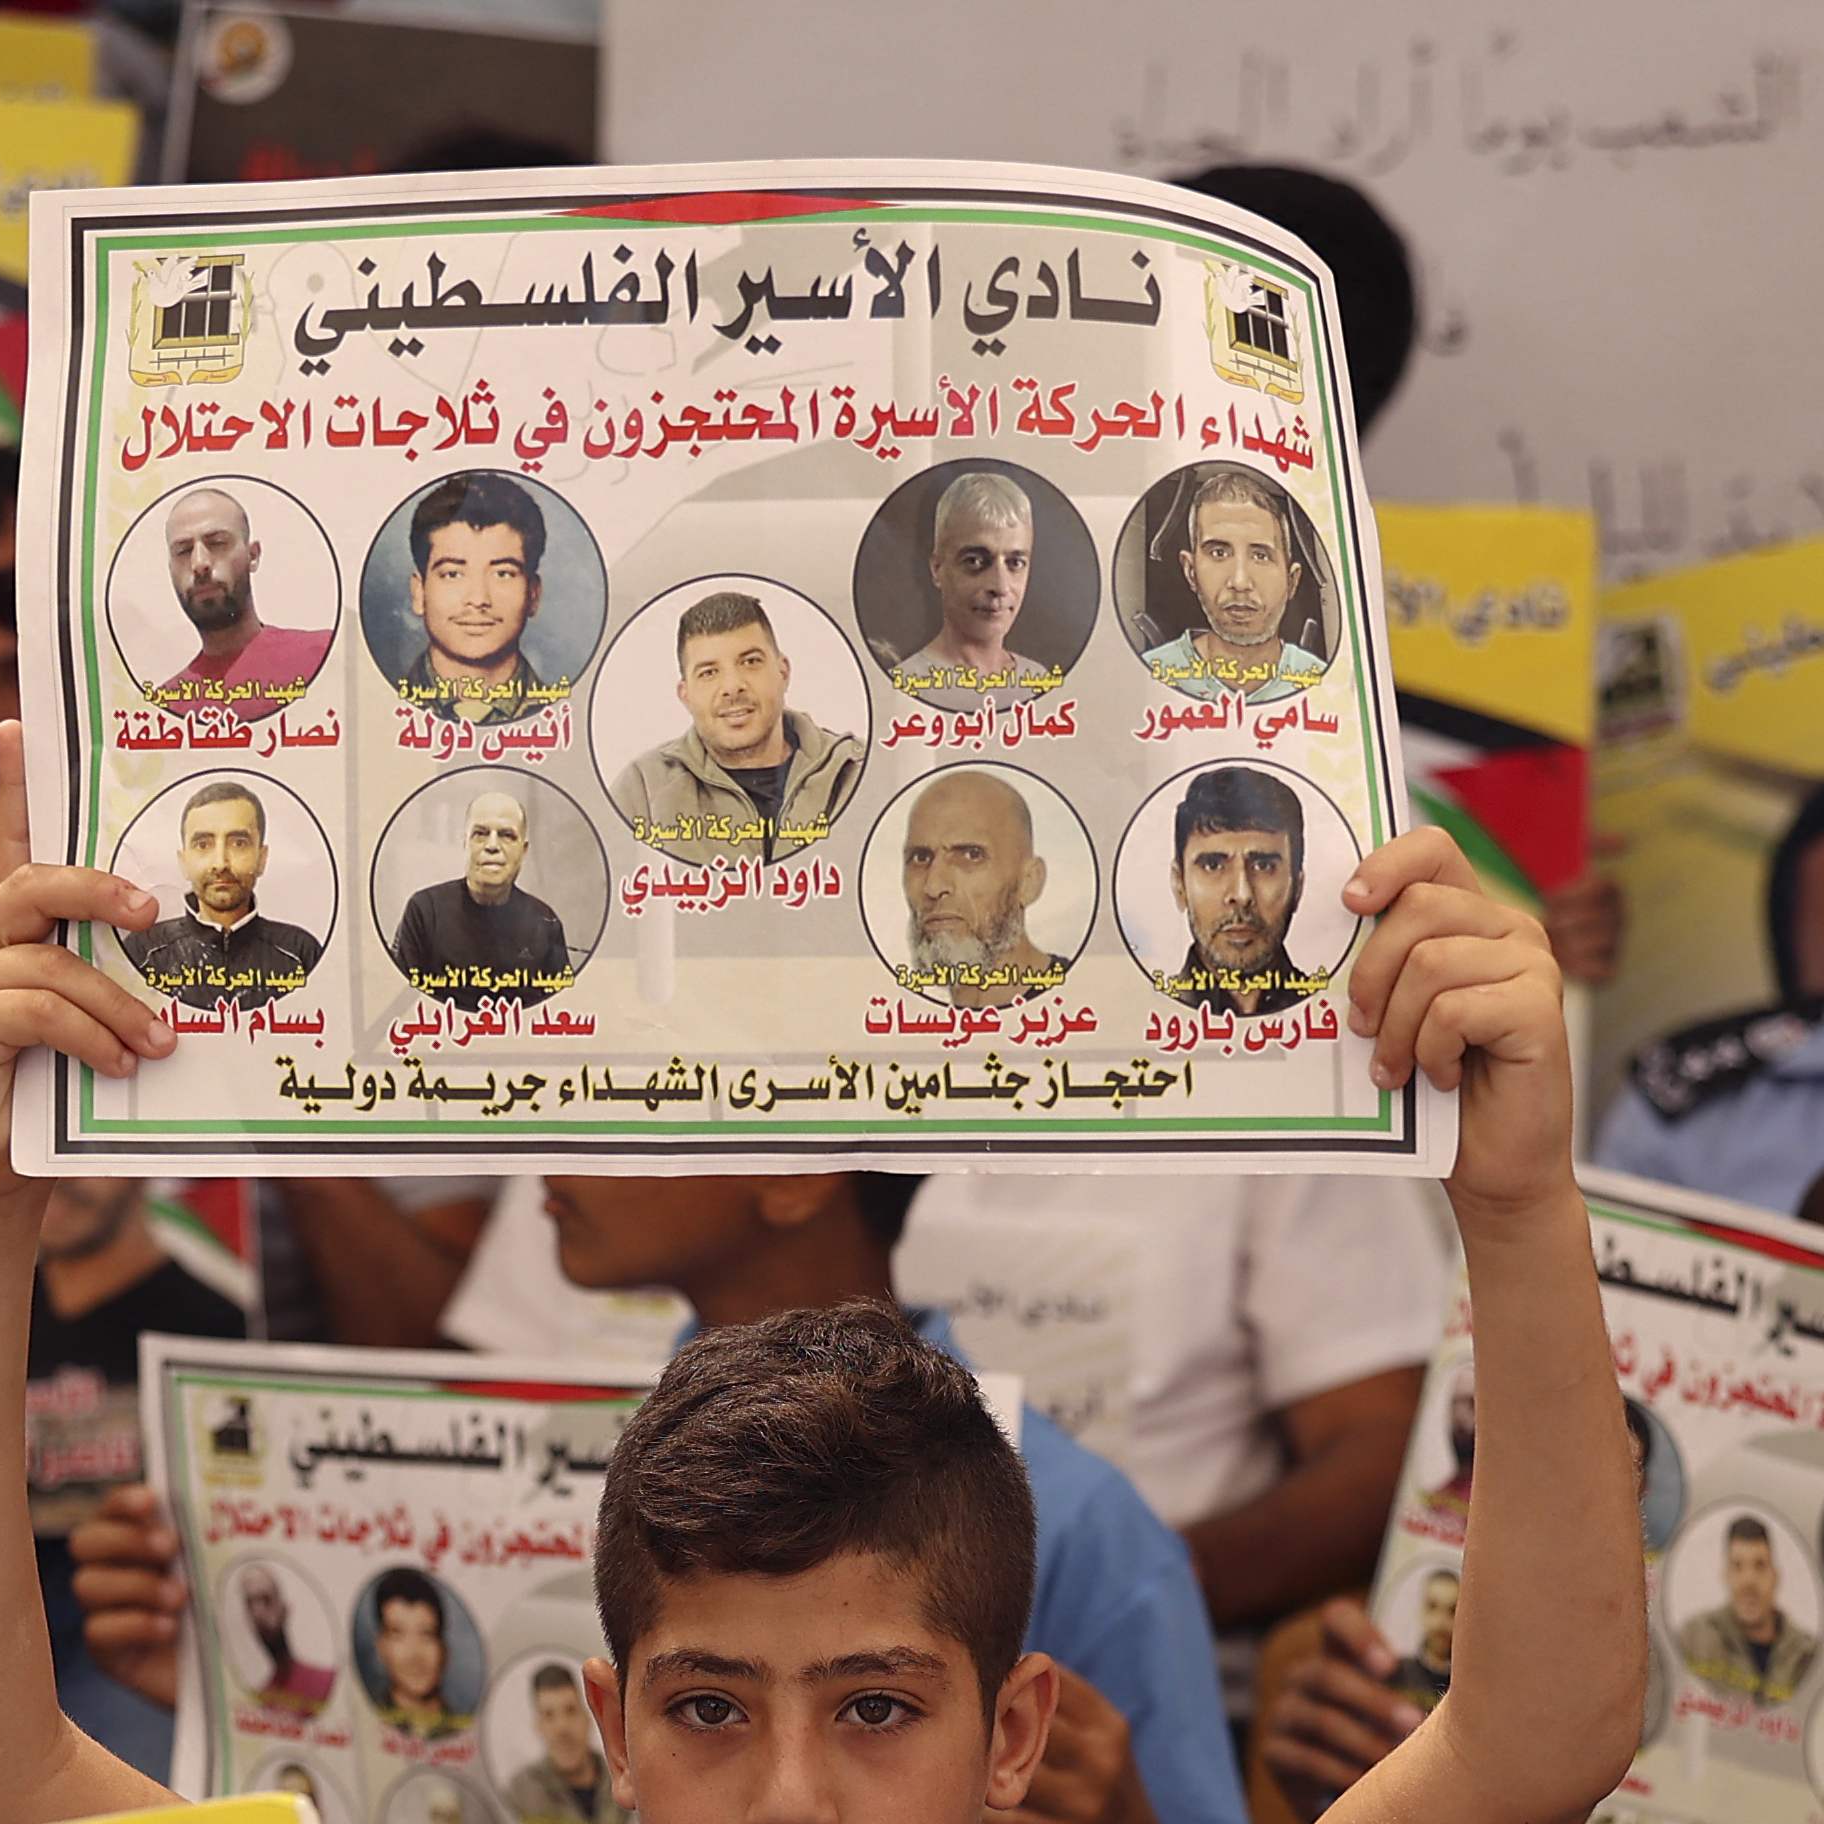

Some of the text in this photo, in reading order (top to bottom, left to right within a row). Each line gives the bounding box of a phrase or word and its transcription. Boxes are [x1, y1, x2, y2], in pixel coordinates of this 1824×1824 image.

[294, 226, 1163, 376] نادي الأسير الفلسطيني
[120, 374, 1314, 474] شهداء الحركة الأسيرة المحتجزون في ثلاجات الاحتلال
[113, 705, 342, 758] نصار طقاطقة
[395, 705, 572, 763] أنيس دولة
[1002, 698, 1077, 749] كمال
[1133, 694, 1339, 751] سامي العمور
[620, 855, 840, 918] داود الزبيدي
[248, 999, 326, 1048] بسام
[388, 996, 596, 1055] سعد الغرابلي
[864, 995, 1099, 1049] عزيز عويسات
[1145, 998, 1340, 1055] فارس بارود
[277, 1051, 1193, 1116] احتجاز جثامين الأسرى الشهداء جريمة دولية
